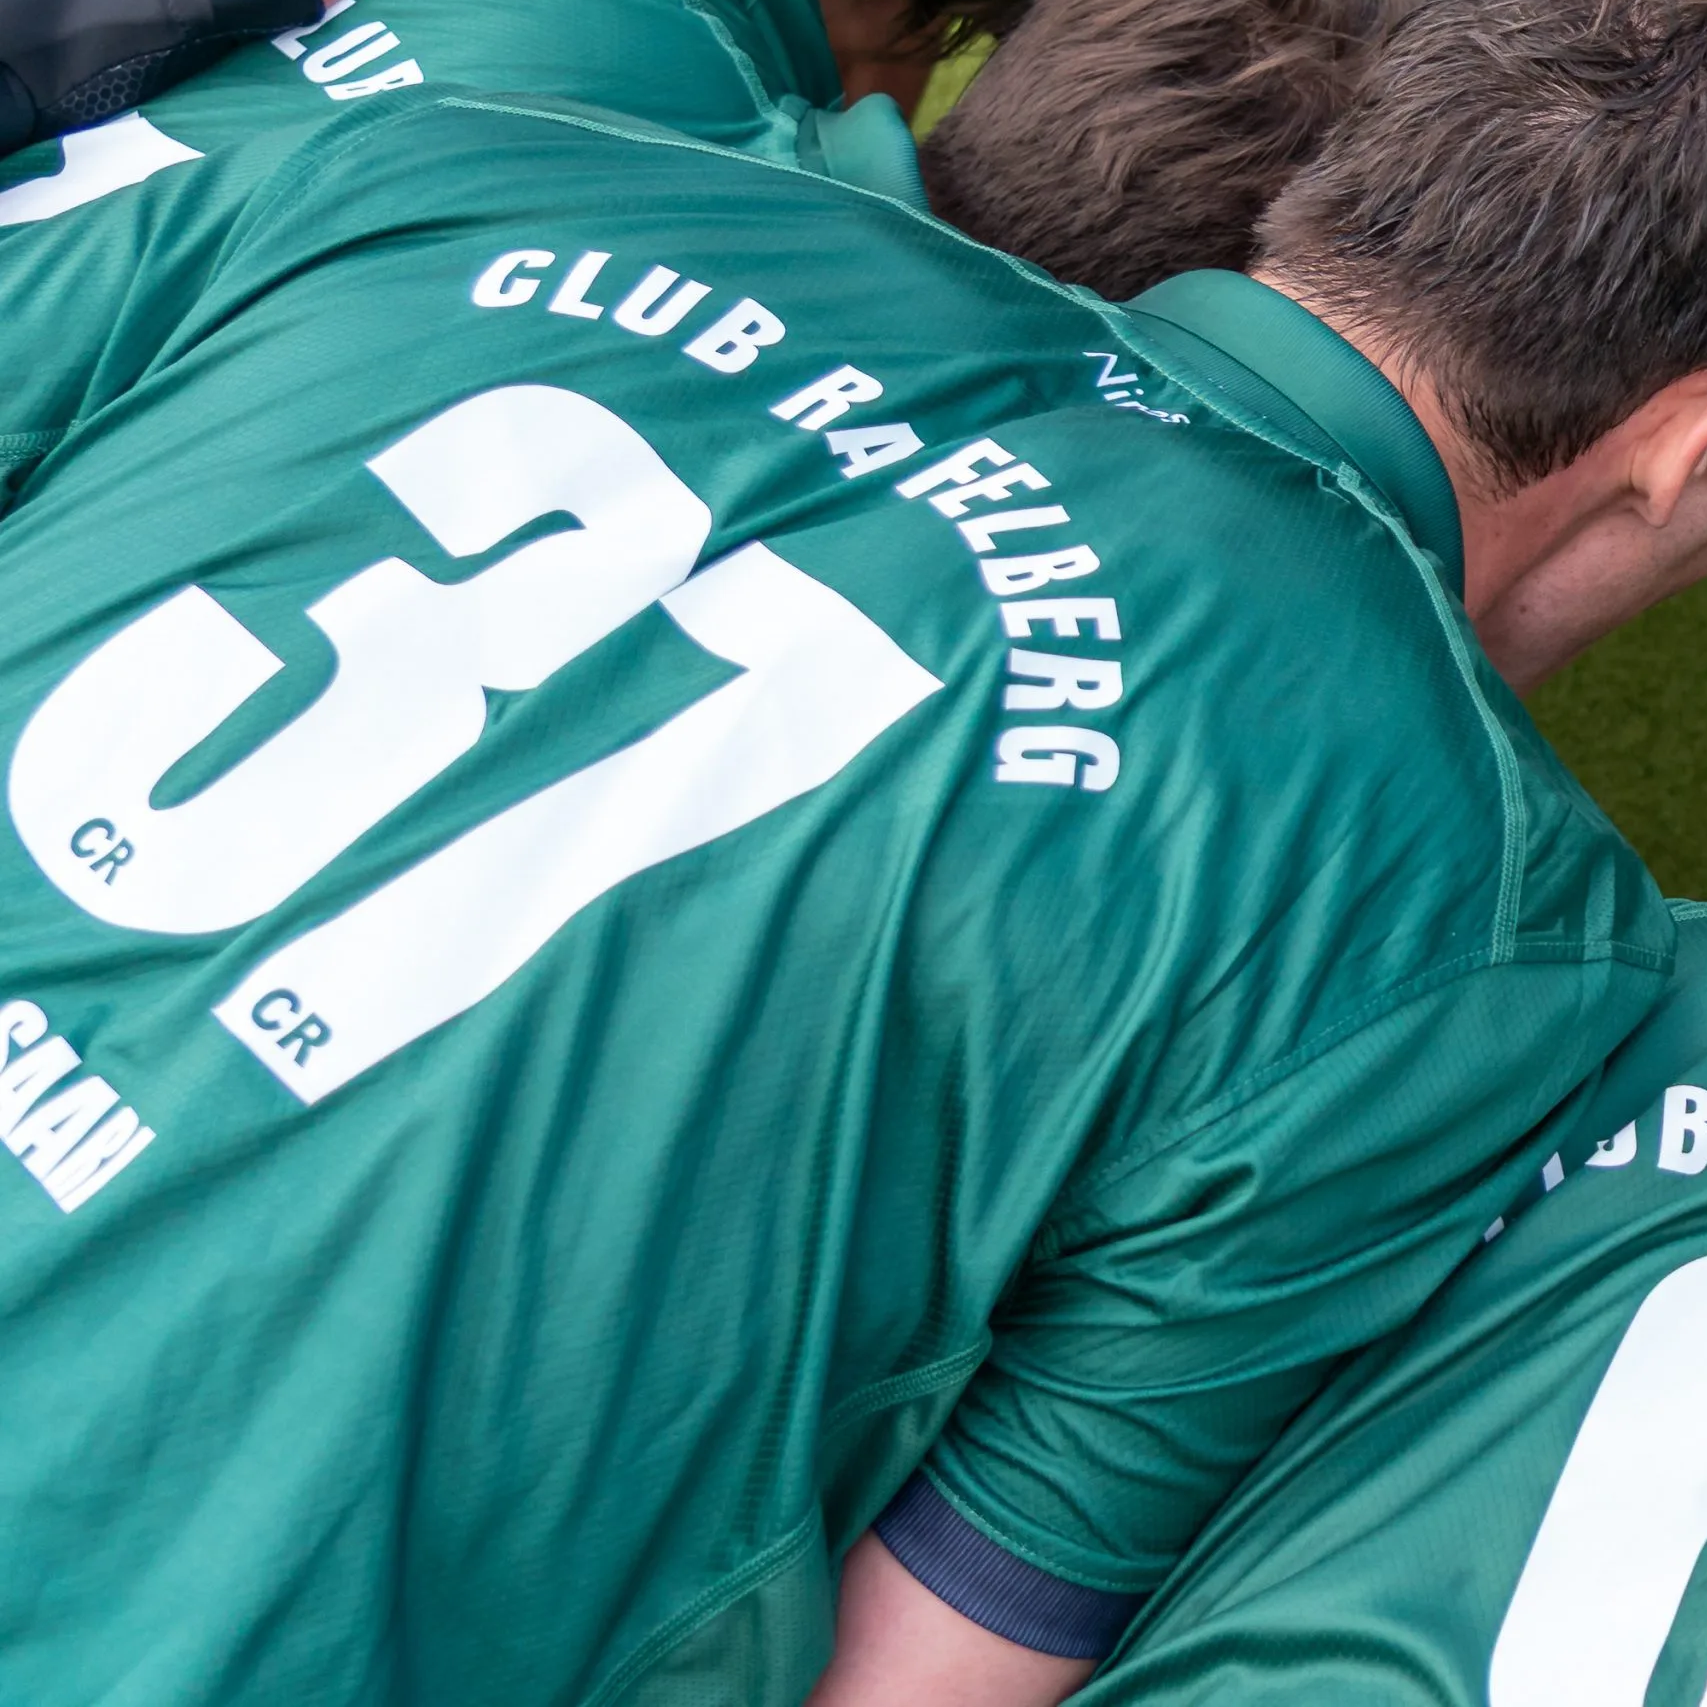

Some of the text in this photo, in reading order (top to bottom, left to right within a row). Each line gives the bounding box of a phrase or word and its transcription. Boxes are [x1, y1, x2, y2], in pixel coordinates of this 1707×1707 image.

[469, 248, 1127, 794] CLUB RAFELBERG
[7, 383, 947, 1106] 37
[68, 816, 136, 888] CR
[248, 986, 334, 1070] CR
